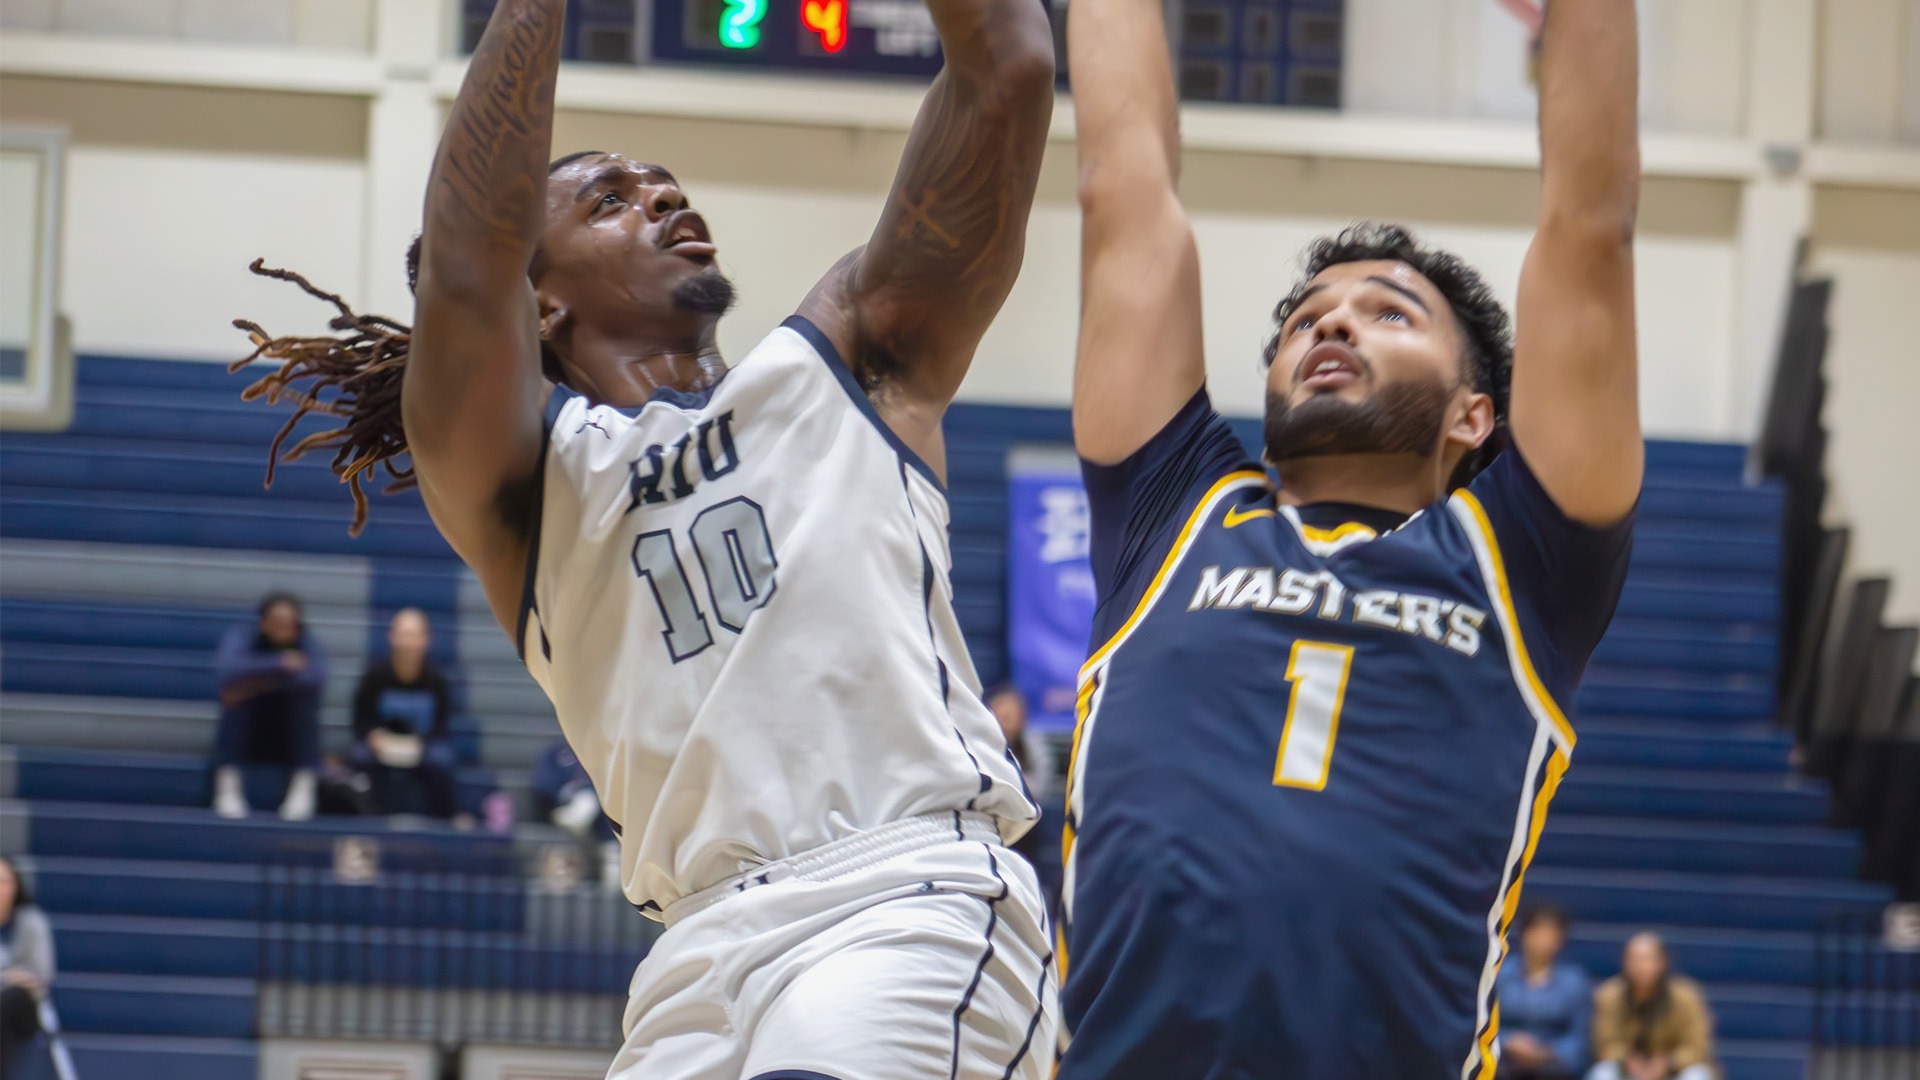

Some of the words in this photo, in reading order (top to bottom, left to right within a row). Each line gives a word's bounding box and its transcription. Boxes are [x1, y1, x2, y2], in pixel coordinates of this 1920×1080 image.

[631, 495, 778, 665] 10
[1186, 565, 1489, 658] MASTER'S
[1272, 638, 1356, 792] 1
